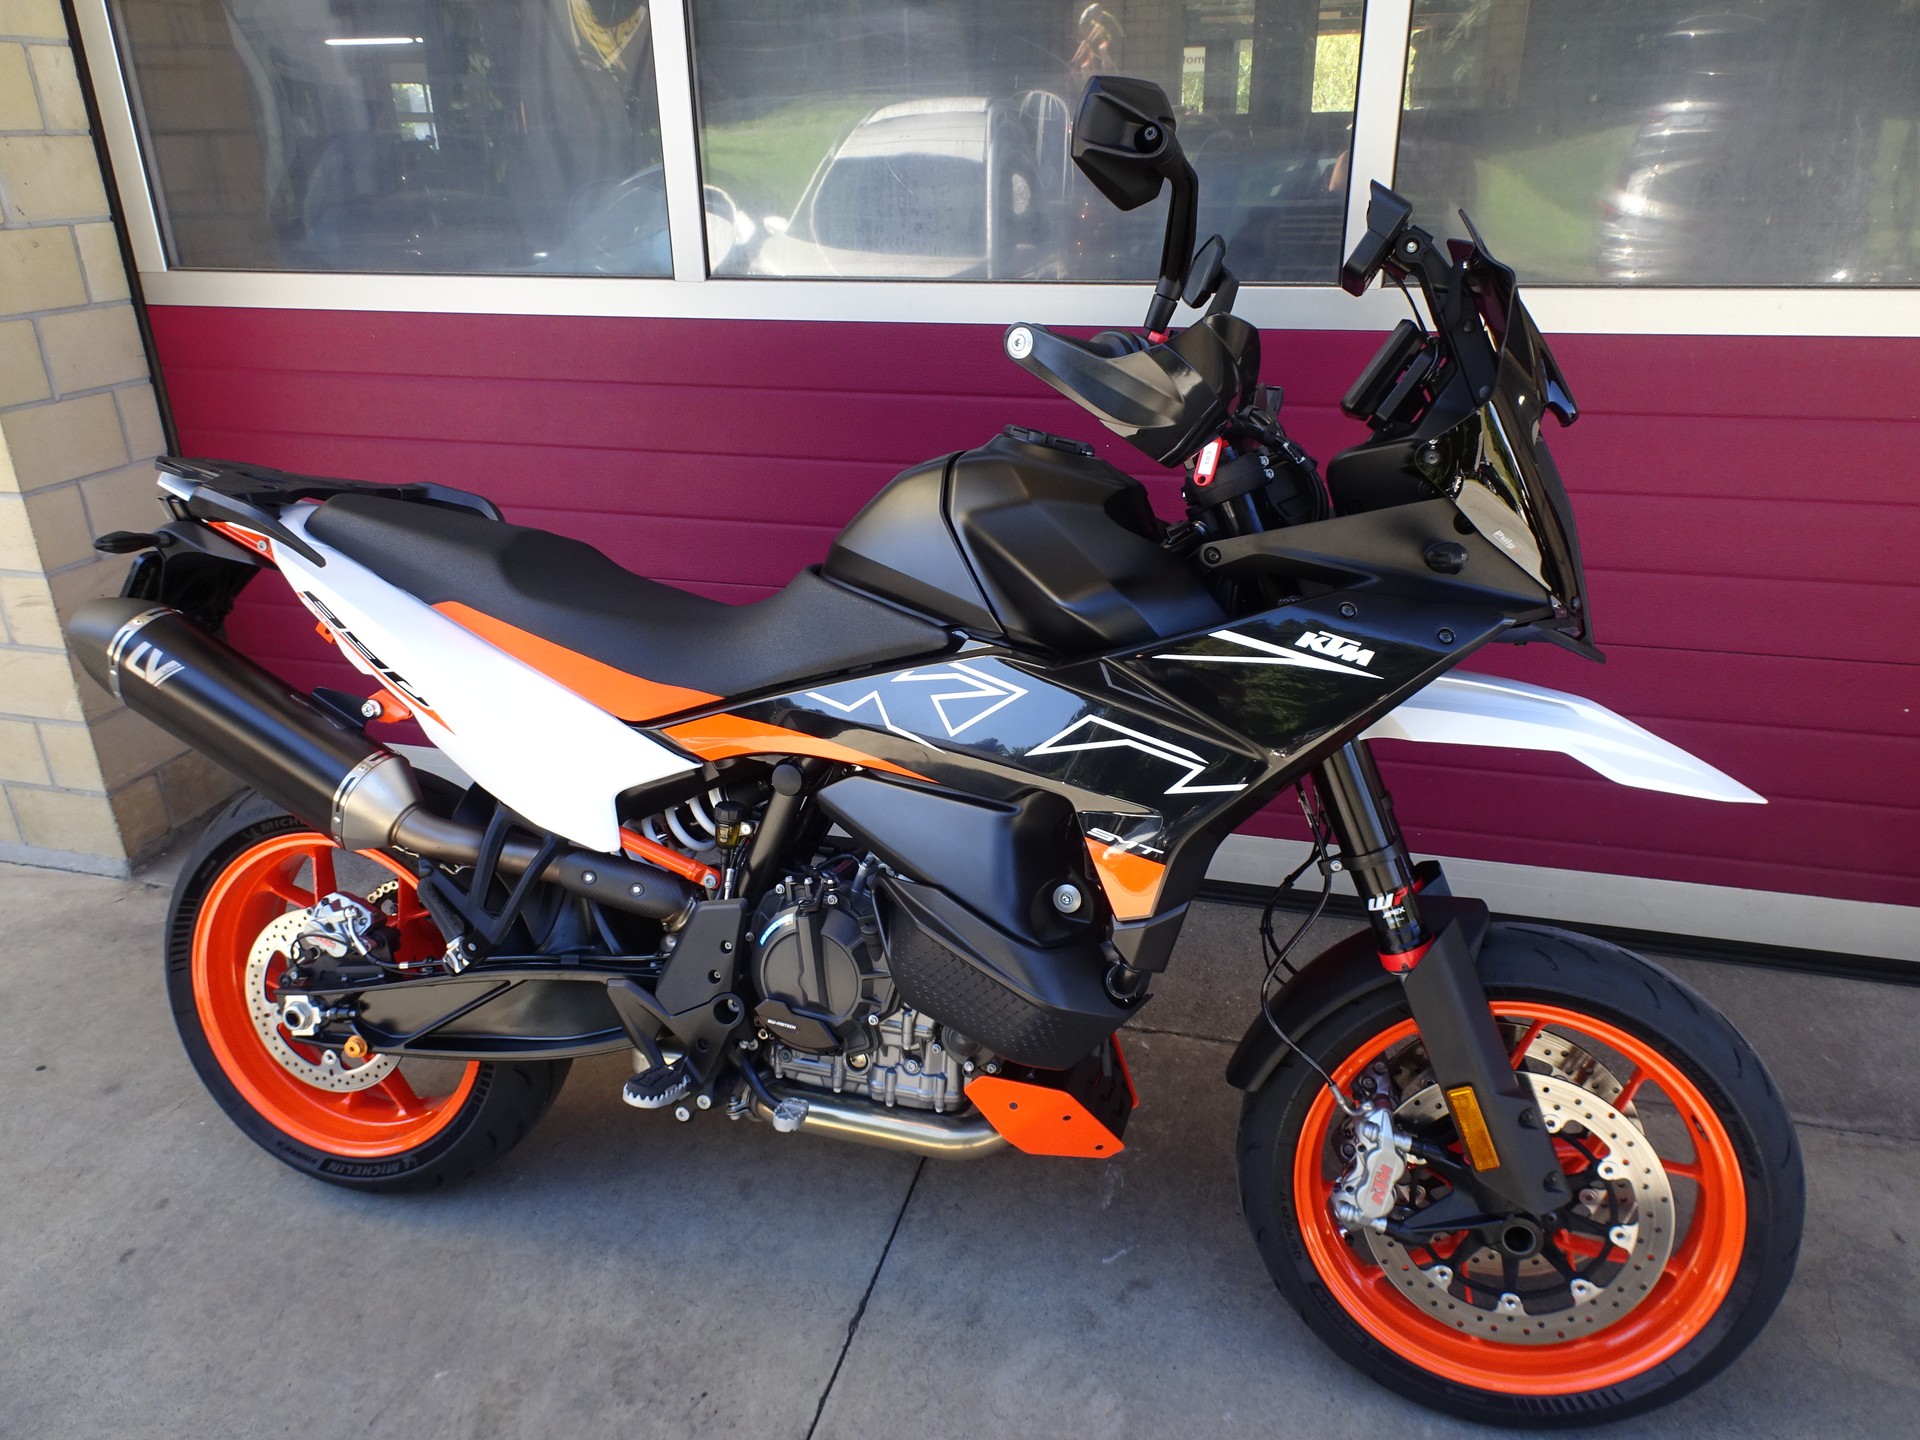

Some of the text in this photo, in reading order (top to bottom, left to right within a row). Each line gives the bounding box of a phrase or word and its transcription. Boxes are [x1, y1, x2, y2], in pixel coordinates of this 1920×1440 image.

[1294, 630, 1375, 667] KTM
[259, 814, 302, 834] MICH
[1087, 827, 1165, 856] SMT
[327, 1159, 400, 1174] MICHELIN
[1371, 1165, 1393, 1206] KTM
